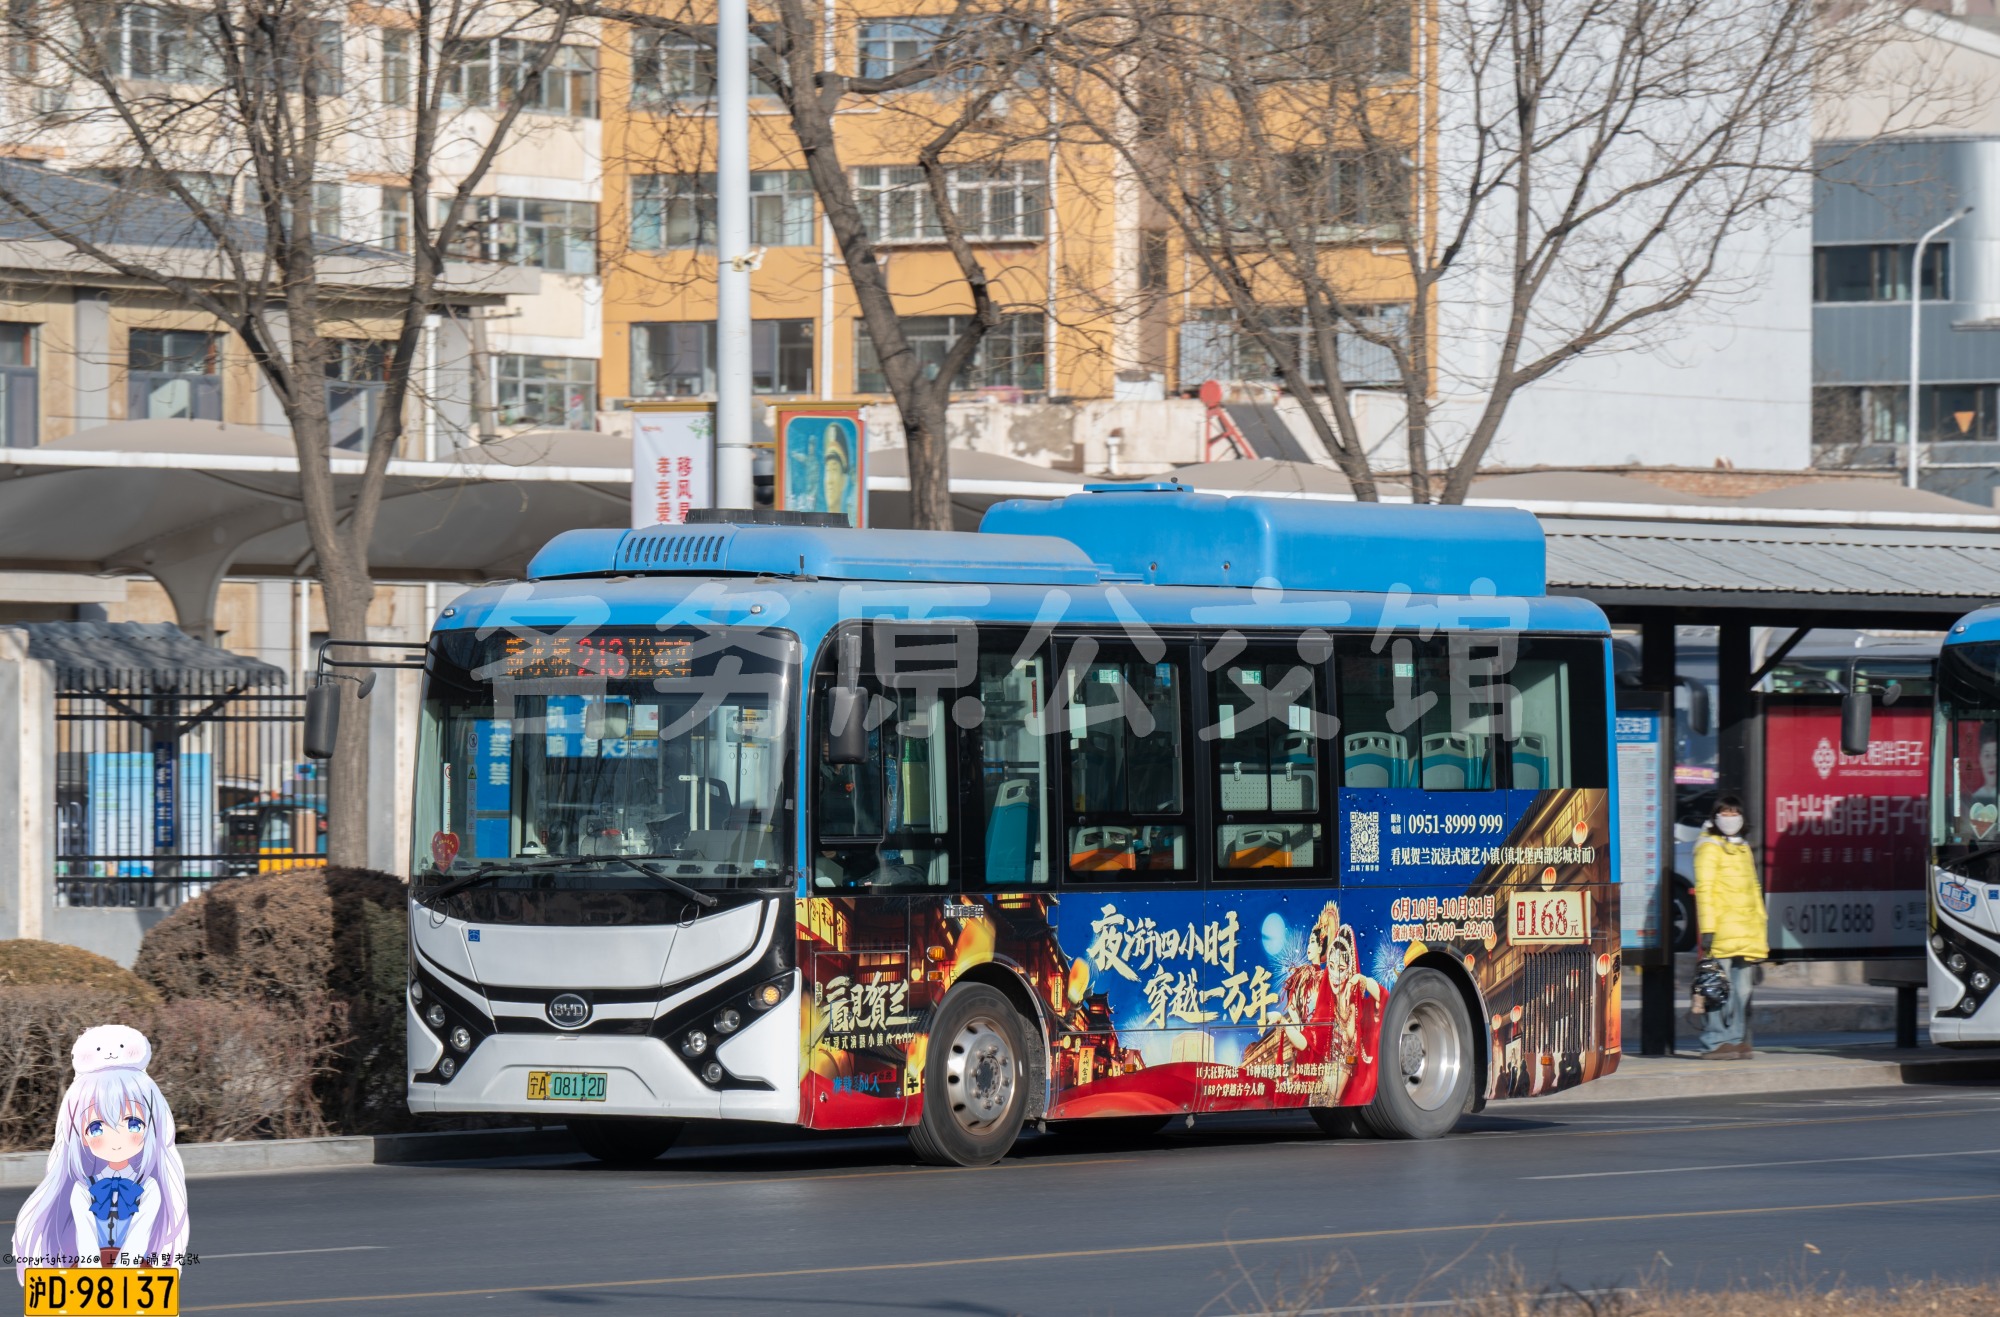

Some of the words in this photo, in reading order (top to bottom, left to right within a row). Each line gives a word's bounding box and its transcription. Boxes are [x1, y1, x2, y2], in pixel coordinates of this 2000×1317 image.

[1408, 814, 1476, 834] 0951-8999
[1479, 814, 1503, 834] 999
[1086, 903, 1242, 983] 夜游四小时
[553, 1003, 584, 1017] BYD
[1143, 963, 1280, 1037] 穿越一万年
